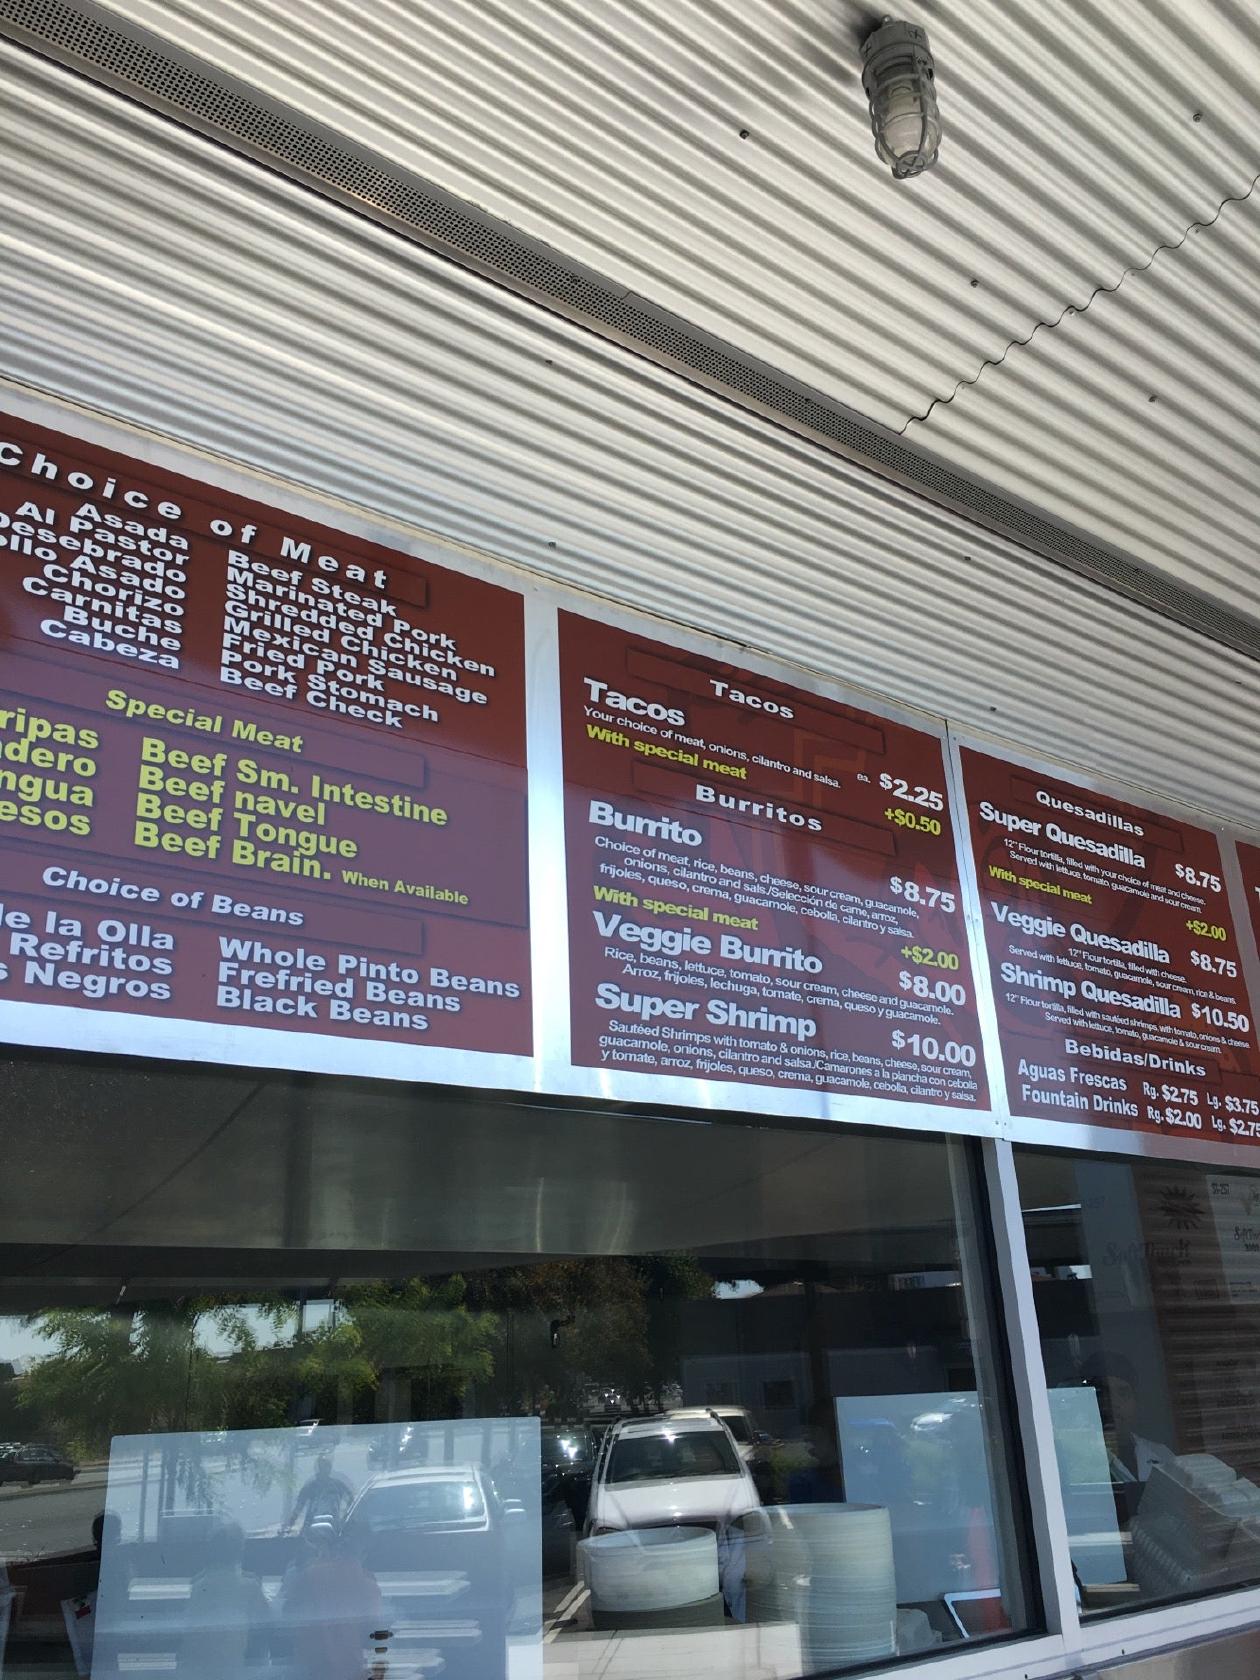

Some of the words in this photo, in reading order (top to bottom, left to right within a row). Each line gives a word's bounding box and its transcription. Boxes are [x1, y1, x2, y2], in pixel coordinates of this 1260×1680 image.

[0, 441, 182, 520] Choice
[210, 520, 257, 544] of
[280, 537, 387, 589] Meat
[16, 501, 55, 525] Al
[70, 515, 189, 565] Pastor
[75, 503, 189, 550] Asada
[23, 577, 182, 634] Carnitas
[43, 564, 184, 616] Chorizo
[70, 555, 186, 599] Asado
[228, 550, 303, 586] Beef
[312, 577, 398, 617] Steak
[63, 606, 181, 651] Buche
[226, 583, 374, 641] Shredded
[384, 633, 495, 677] Chicken
[227, 566, 383, 627] Marinated
[393, 618, 457, 650] Pork
[40, 619, 179, 669] Cabeza
[222, 633, 305, 669] Fried
[317, 659, 385, 691] Pork
[223, 615, 358, 668] Mexican
[368, 658, 488, 705] Sausage
[224, 600, 330, 644] Grilled
[341, 635, 458, 681] Chicken
[220, 667, 297, 700] Beef
[306, 691, 403, 728] Check
[221, 650, 297, 684] Pork
[307, 674, 439, 722] Stomach
[583, 677, 686, 726] Tacos
[710, 679, 795, 719] Tacos
[106, 689, 223, 733] Special
[232, 719, 305, 753] Meat
[583, 705, 614, 723] Your
[617, 716, 657, 735] choice
[660, 729, 675, 740] of
[674, 732, 706, 749] meat,
[709, 742, 749, 761] onions,
[752, 755, 791, 774] cilantro
[792, 765, 812, 780] and
[814, 772, 841, 788] salsa.
[0, 737, 96, 777] dero
[141, 737, 227, 777] Beef
[236, 759, 299, 794] Sm.
[311, 775, 449, 826] Intestine
[587, 724, 630, 748] With
[634, 739, 698, 766] special
[703, 759, 747, 780] meat
[884, 808, 941, 836] +$0.50
[139, 764, 225, 804] Beef
[235, 791, 326, 825] navel
[696, 784, 822, 832] Burritos
[857, 773, 871, 783] ea.
[879, 773, 943, 811] $2.25
[1036, 790, 1144, 836] Quesadillas
[136, 792, 223, 831] Beef
[234, 813, 358, 858] Tongue
[980, 801, 1042, 836] Super
[1046, 822, 1145, 868] Quesadilla
[1175, 863, 1221, 893] $8.75
[134, 821, 221, 859] Beef
[232, 839, 331, 880] Brain.
[342, 870, 389, 891] When
[394, 880, 469, 904] Available
[589, 800, 702, 846] Burrito
[890, 876, 955, 913] $8.75
[595, 836, 640, 854] Choice
[643, 849, 657, 858] of
[658, 852, 690, 866] meat,
[694, 859, 718, 872] rice,
[720, 864, 758, 882] beans,
[760, 874, 802, 892] cheese,
[804, 884, 829, 895] sour
[830, 890, 863, 906] cream,
[42, 866, 160, 902] Choice
[171, 892, 204, 909] of
[211, 894, 304, 925] Beans
[989, 865, 1016, 883] With
[1019, 876, 1060, 895] special
[1186, 920, 1226, 941] +$2.00
[9, 932, 173, 975] Refritos
[46, 911, 82, 937] la
[98, 920, 174, 950] Olla
[593, 886, 638, 907] With
[643, 898, 709, 921] special
[713, 912, 758, 930] meat
[901, 946, 959, 970] +$2.00
[593, 911, 712, 955] Veggie
[720, 934, 823, 974] Burrito
[899, 970, 966, 1006] $8.00
[991, 901, 1066, 938] Veggie
[1070, 923, 1170, 964] Quesadilla
[1190, 950, 1237, 978] $8.75
[24, 961, 171, 1000] Negros
[219, 936, 326, 972] Whole
[338, 954, 419, 984] Pinto
[430, 968, 520, 997] Beans
[219, 961, 354, 998] Frefried
[366, 981, 461, 1012] Beans
[605, 947, 636, 962] Rice,
[640, 953, 682, 970] beans,
[685, 961, 726, 977] lettuce,
[730, 969, 773, 986] tomato,
[776, 978, 802, 989] sour
[803, 982, 839, 997] cream,
[842, 988, 878, 1002] cheese
[879, 995, 898, 1005] and
[1001, 962, 1076, 999] Shrimp
[1081, 980, 1181, 1018] Quesadilla
[1191, 1003, 1249, 1032] $10.50
[216, 986, 318, 1019] Black
[330, 1000, 429, 1030] Beans
[595, 983, 699, 1021] Super
[706, 998, 816, 1041] Shrimp
[892, 1029, 976, 1067] $10.00
[661, 1028, 711, 1044] Shrimps
[713, 1035, 737, 1047] with
[739, 1040, 777, 1052] tomato
[780, 1042, 790, 1052] &
[791, 1045, 828, 1060] onions,
[852, 1053, 883, 1067] beans,
[921, 1064, 942, 1076] sour
[1065, 1039, 1206, 1077] Bebidas/Drinks
[1018, 1059, 1065, 1082] Aguas
[1070, 1067, 1128, 1091] Frescas
[1143, 1082, 1159, 1100] Rg.
[1162, 1084, 1199, 1106] $2.75
[1207, 1092, 1221, 1109] Lg.
[1225, 1096, 1260, 1115] $3.75
[1022, 1084, 1089, 1110] Fountain
[1093, 1094, 1139, 1117] Drinks
[1147, 1106, 1164, 1124] Rg.
[1166, 1109, 1202, 1130] $2.00
[1212, 1115, 1226, 1132] Lg.
